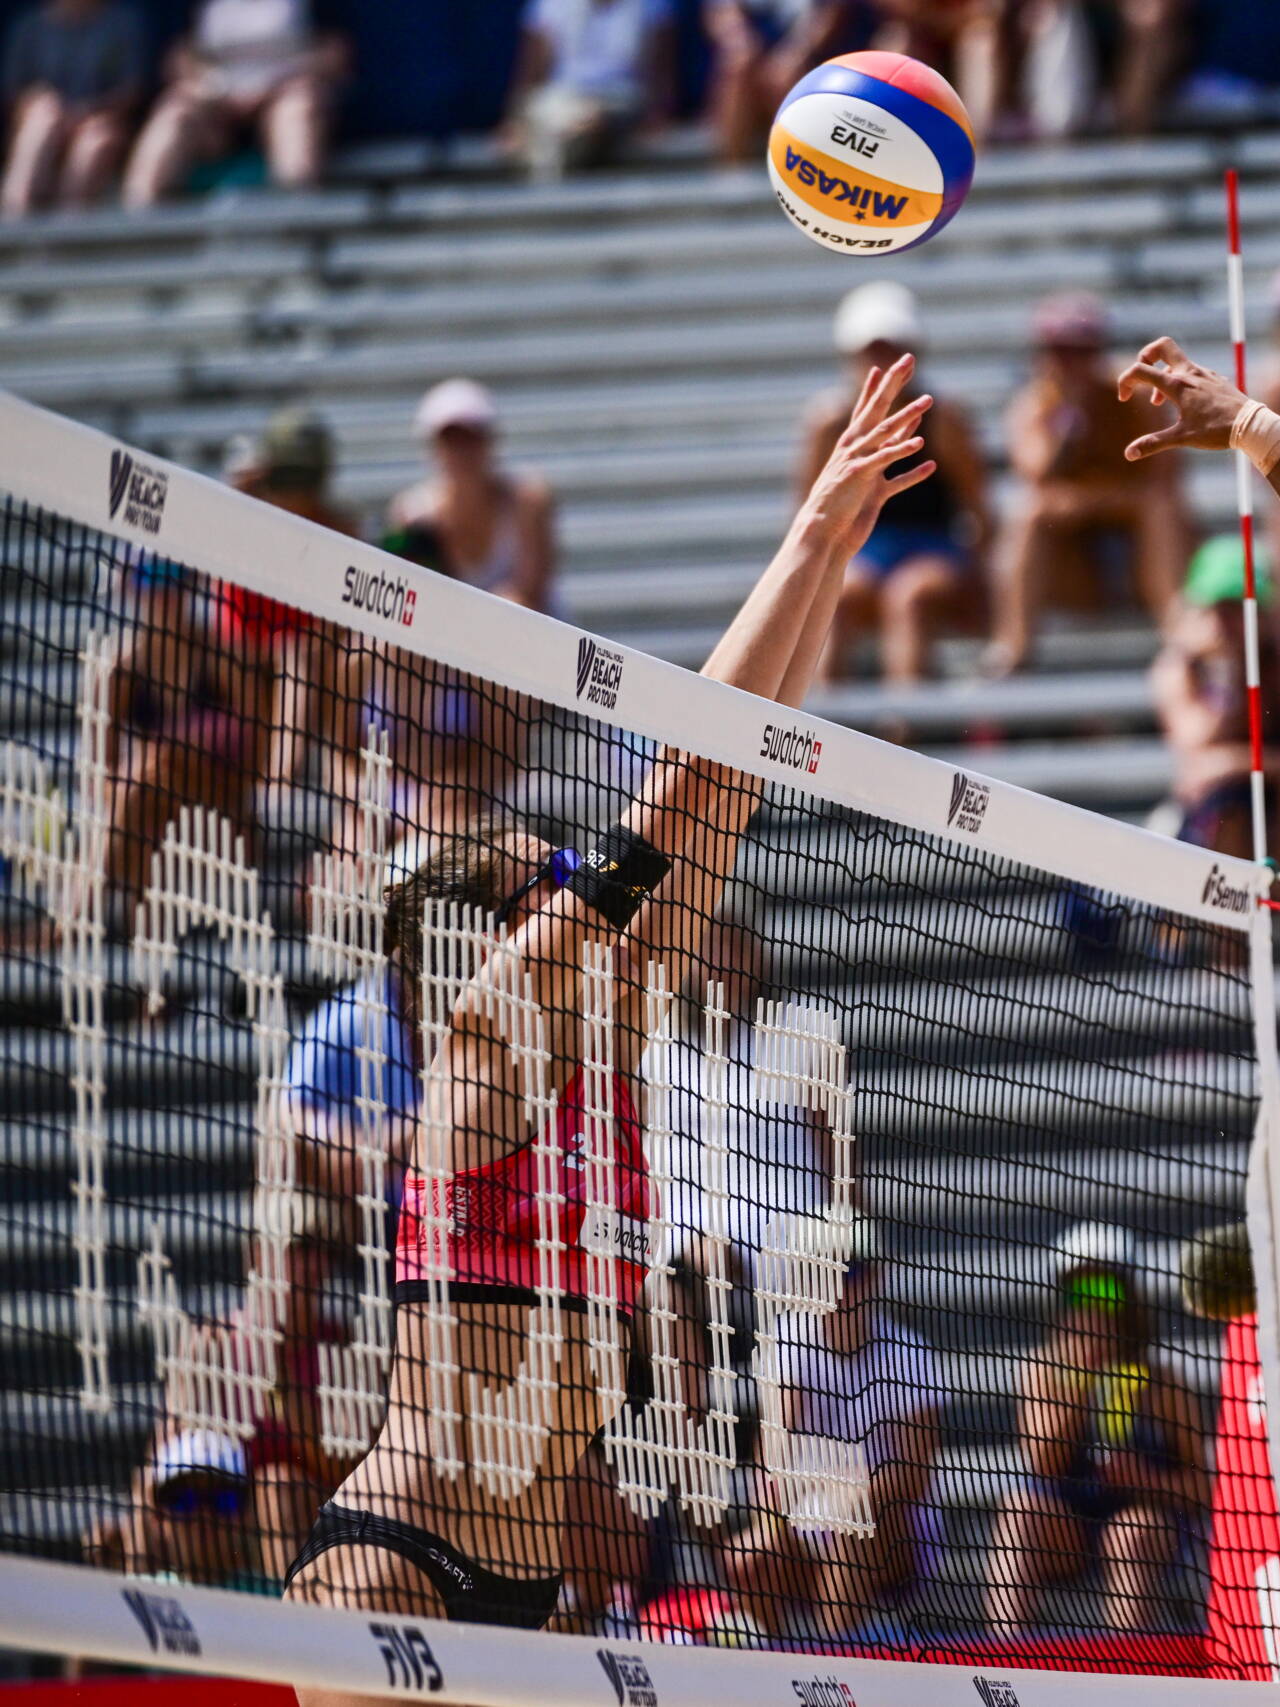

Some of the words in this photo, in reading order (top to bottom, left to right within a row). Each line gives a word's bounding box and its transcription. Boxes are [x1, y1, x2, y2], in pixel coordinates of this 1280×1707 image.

[785, 144, 910, 221] MIKASA
[813, 227, 894, 249] BEACH
[342, 565, 406, 623] swatch
[591, 656, 623, 691] BEACH
[587, 684, 601, 704] PRO
[600, 688, 617, 710] TOUR
[760, 724, 813, 771] swatch
[962, 789, 989, 818] BEACH
[427, 1547, 466, 1583] CRAFT
[618, 1664, 654, 1688] BEACH
[791, 1674, 848, 1707] swatch
